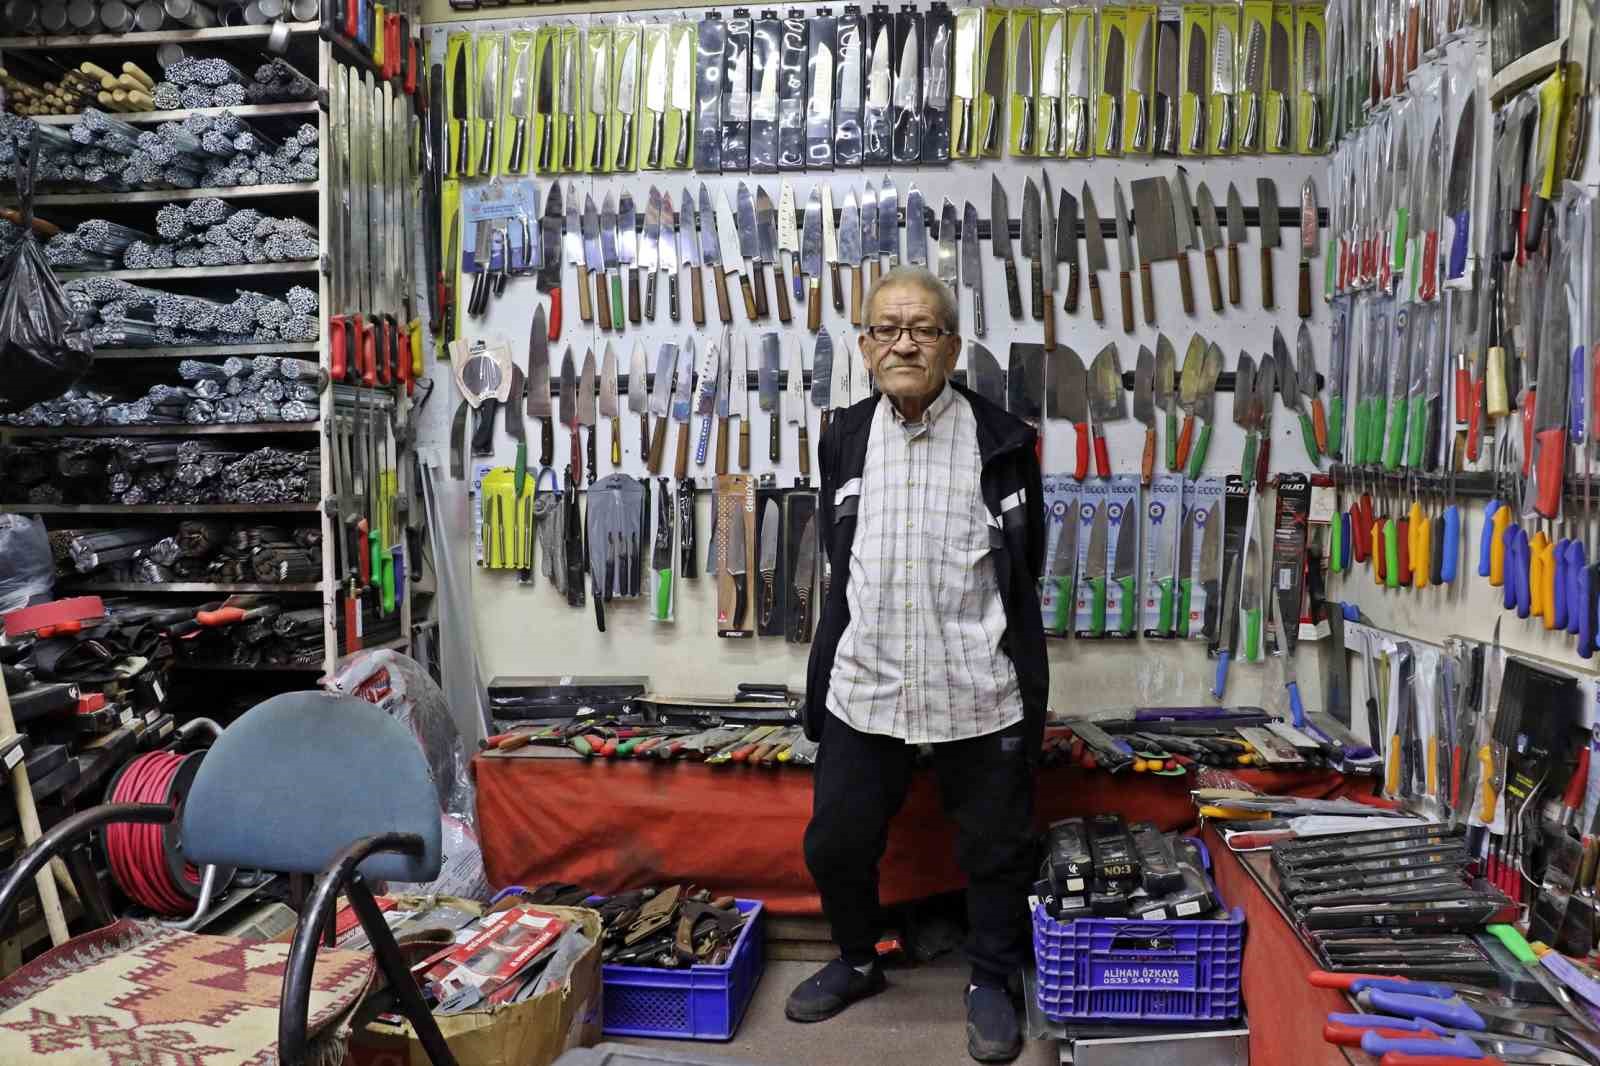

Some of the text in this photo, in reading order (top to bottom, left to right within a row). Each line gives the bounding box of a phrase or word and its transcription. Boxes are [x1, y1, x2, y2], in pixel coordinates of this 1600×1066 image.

[1104, 864, 1132, 876] NO:3
[1104, 967, 1179, 978] ALİHAN ÖZKAYA
